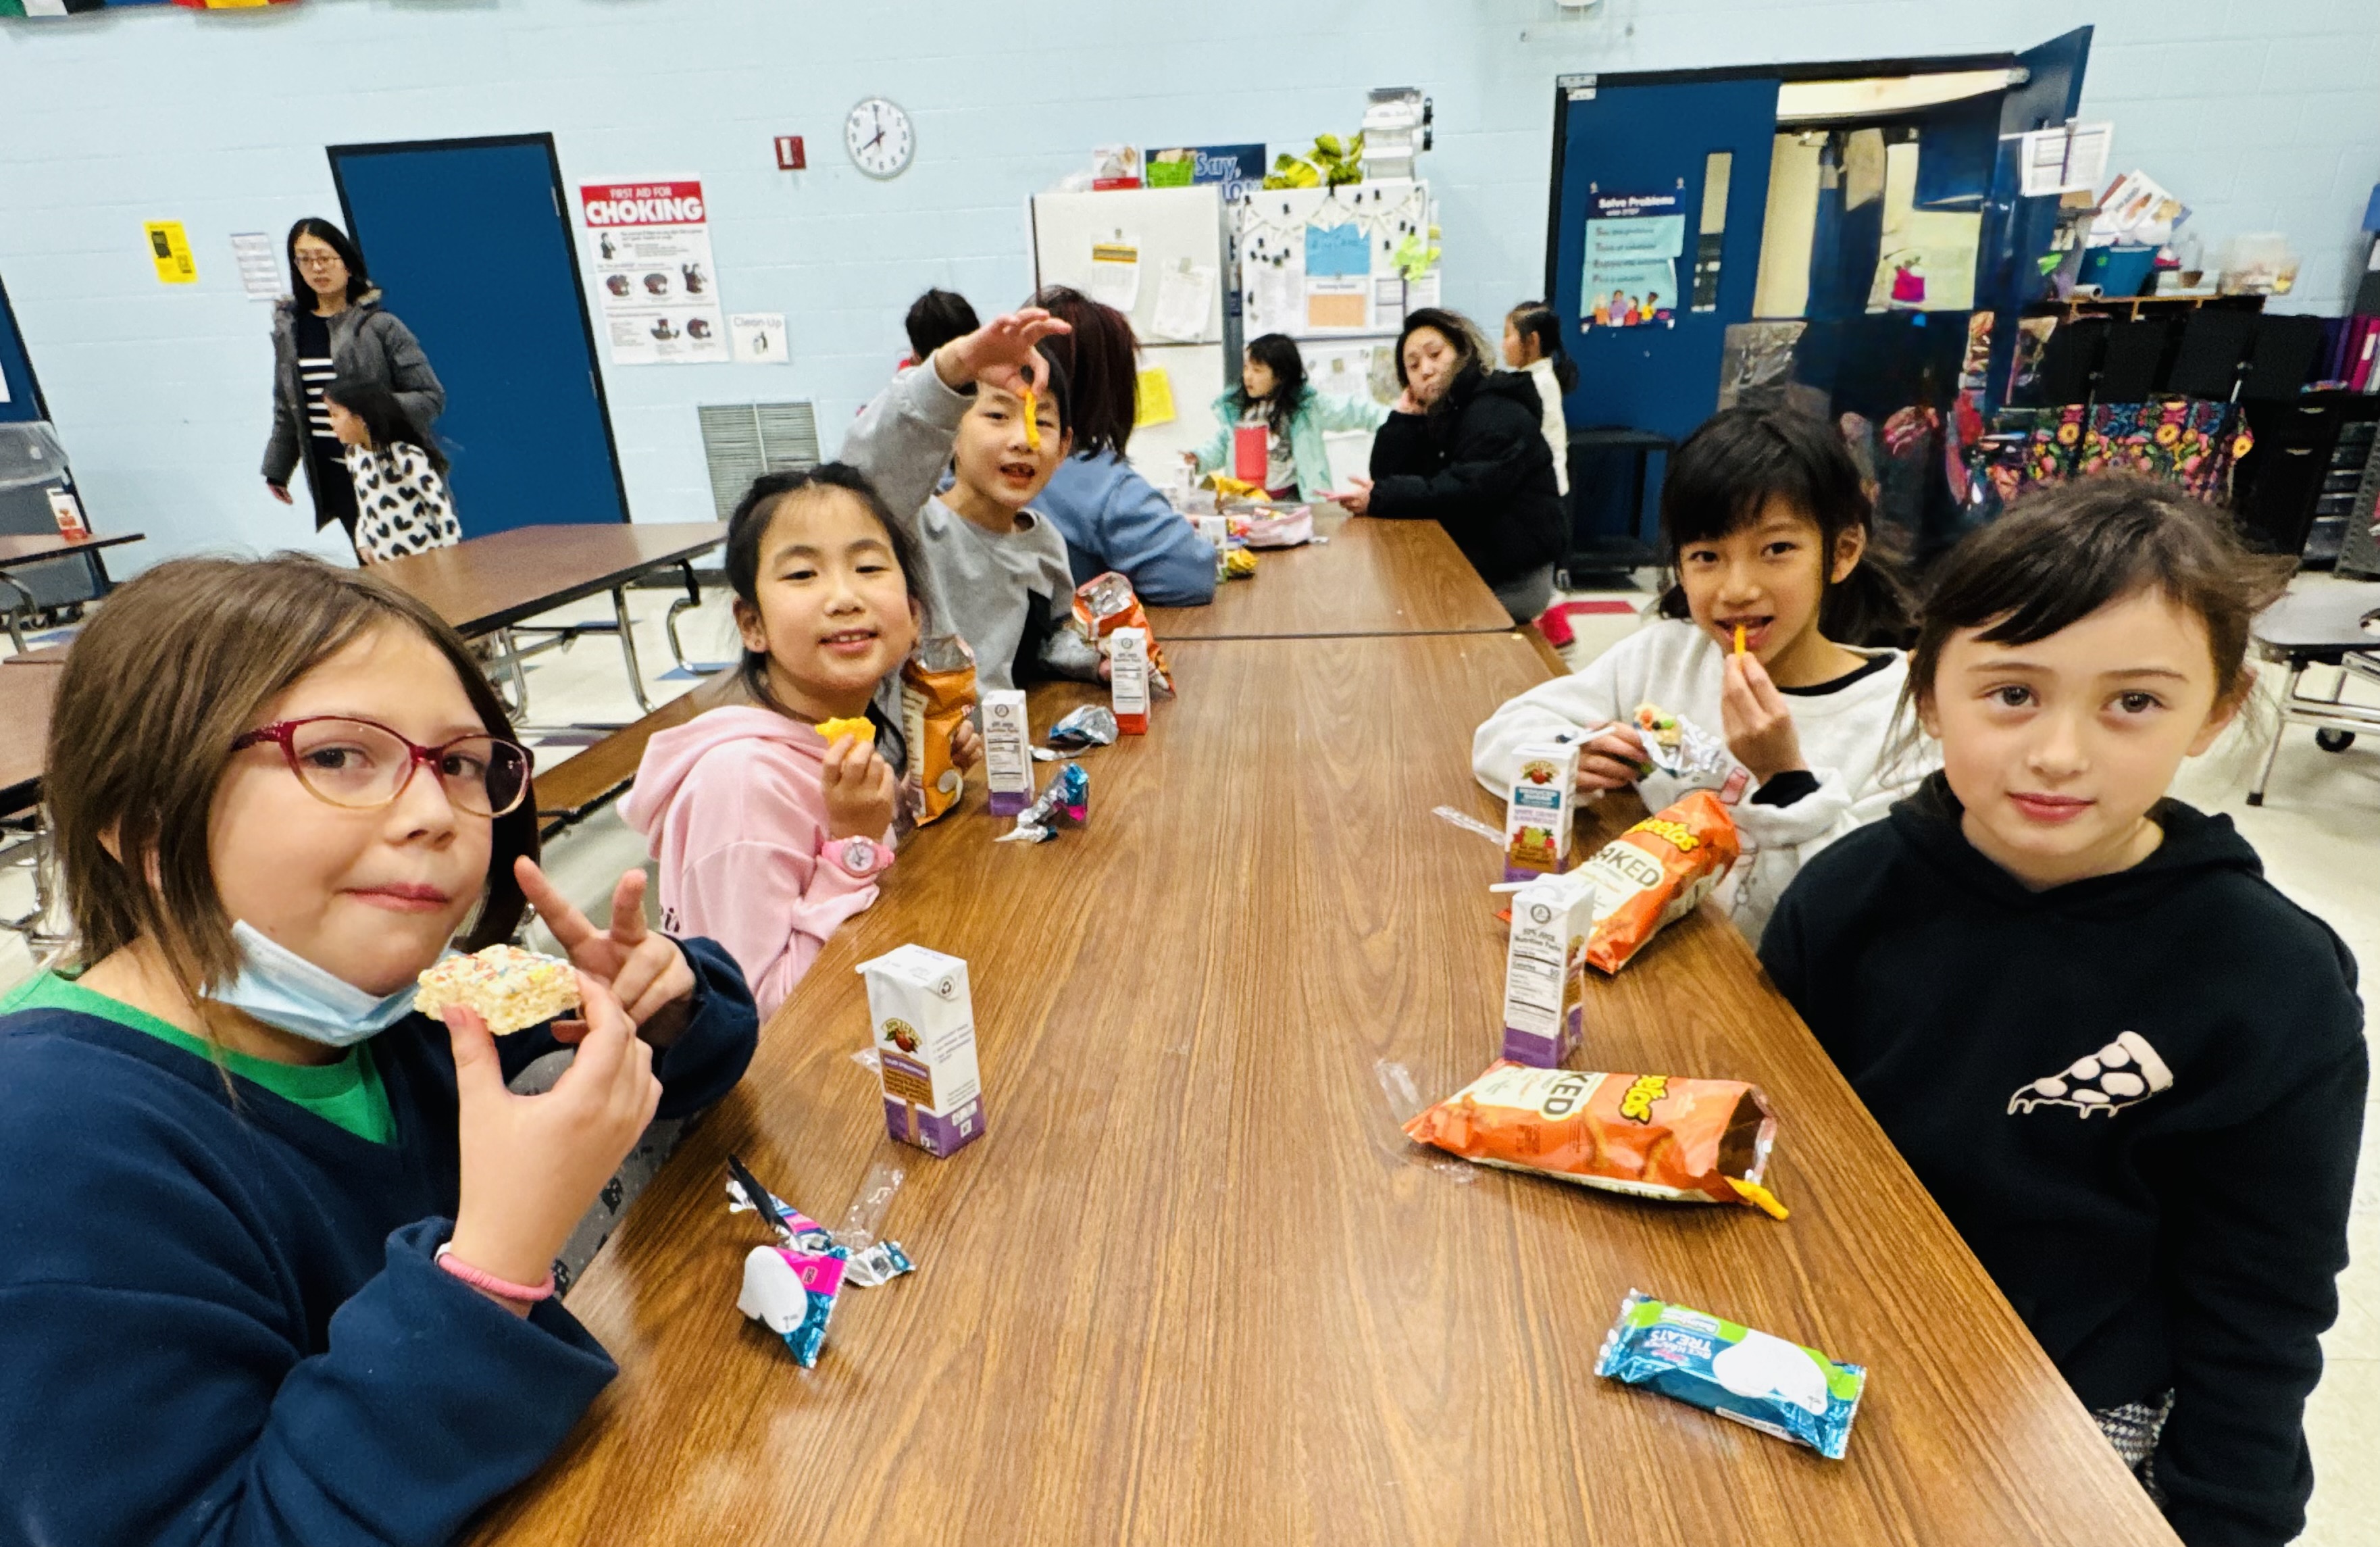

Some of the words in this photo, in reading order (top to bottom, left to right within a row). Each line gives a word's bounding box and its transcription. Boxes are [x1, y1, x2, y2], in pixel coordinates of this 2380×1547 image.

[609, 188, 633, 199] FIRST
[636, 187, 651, 198] AID
[653, 186, 672, 197] FOR
[586, 196, 704, 225] CHOKING
[734, 315, 766, 328] Clean
[767, 316, 783, 330] Up
[1590, 847, 1661, 887] AKED
[1650, 1329, 1712, 1354] TREATS
